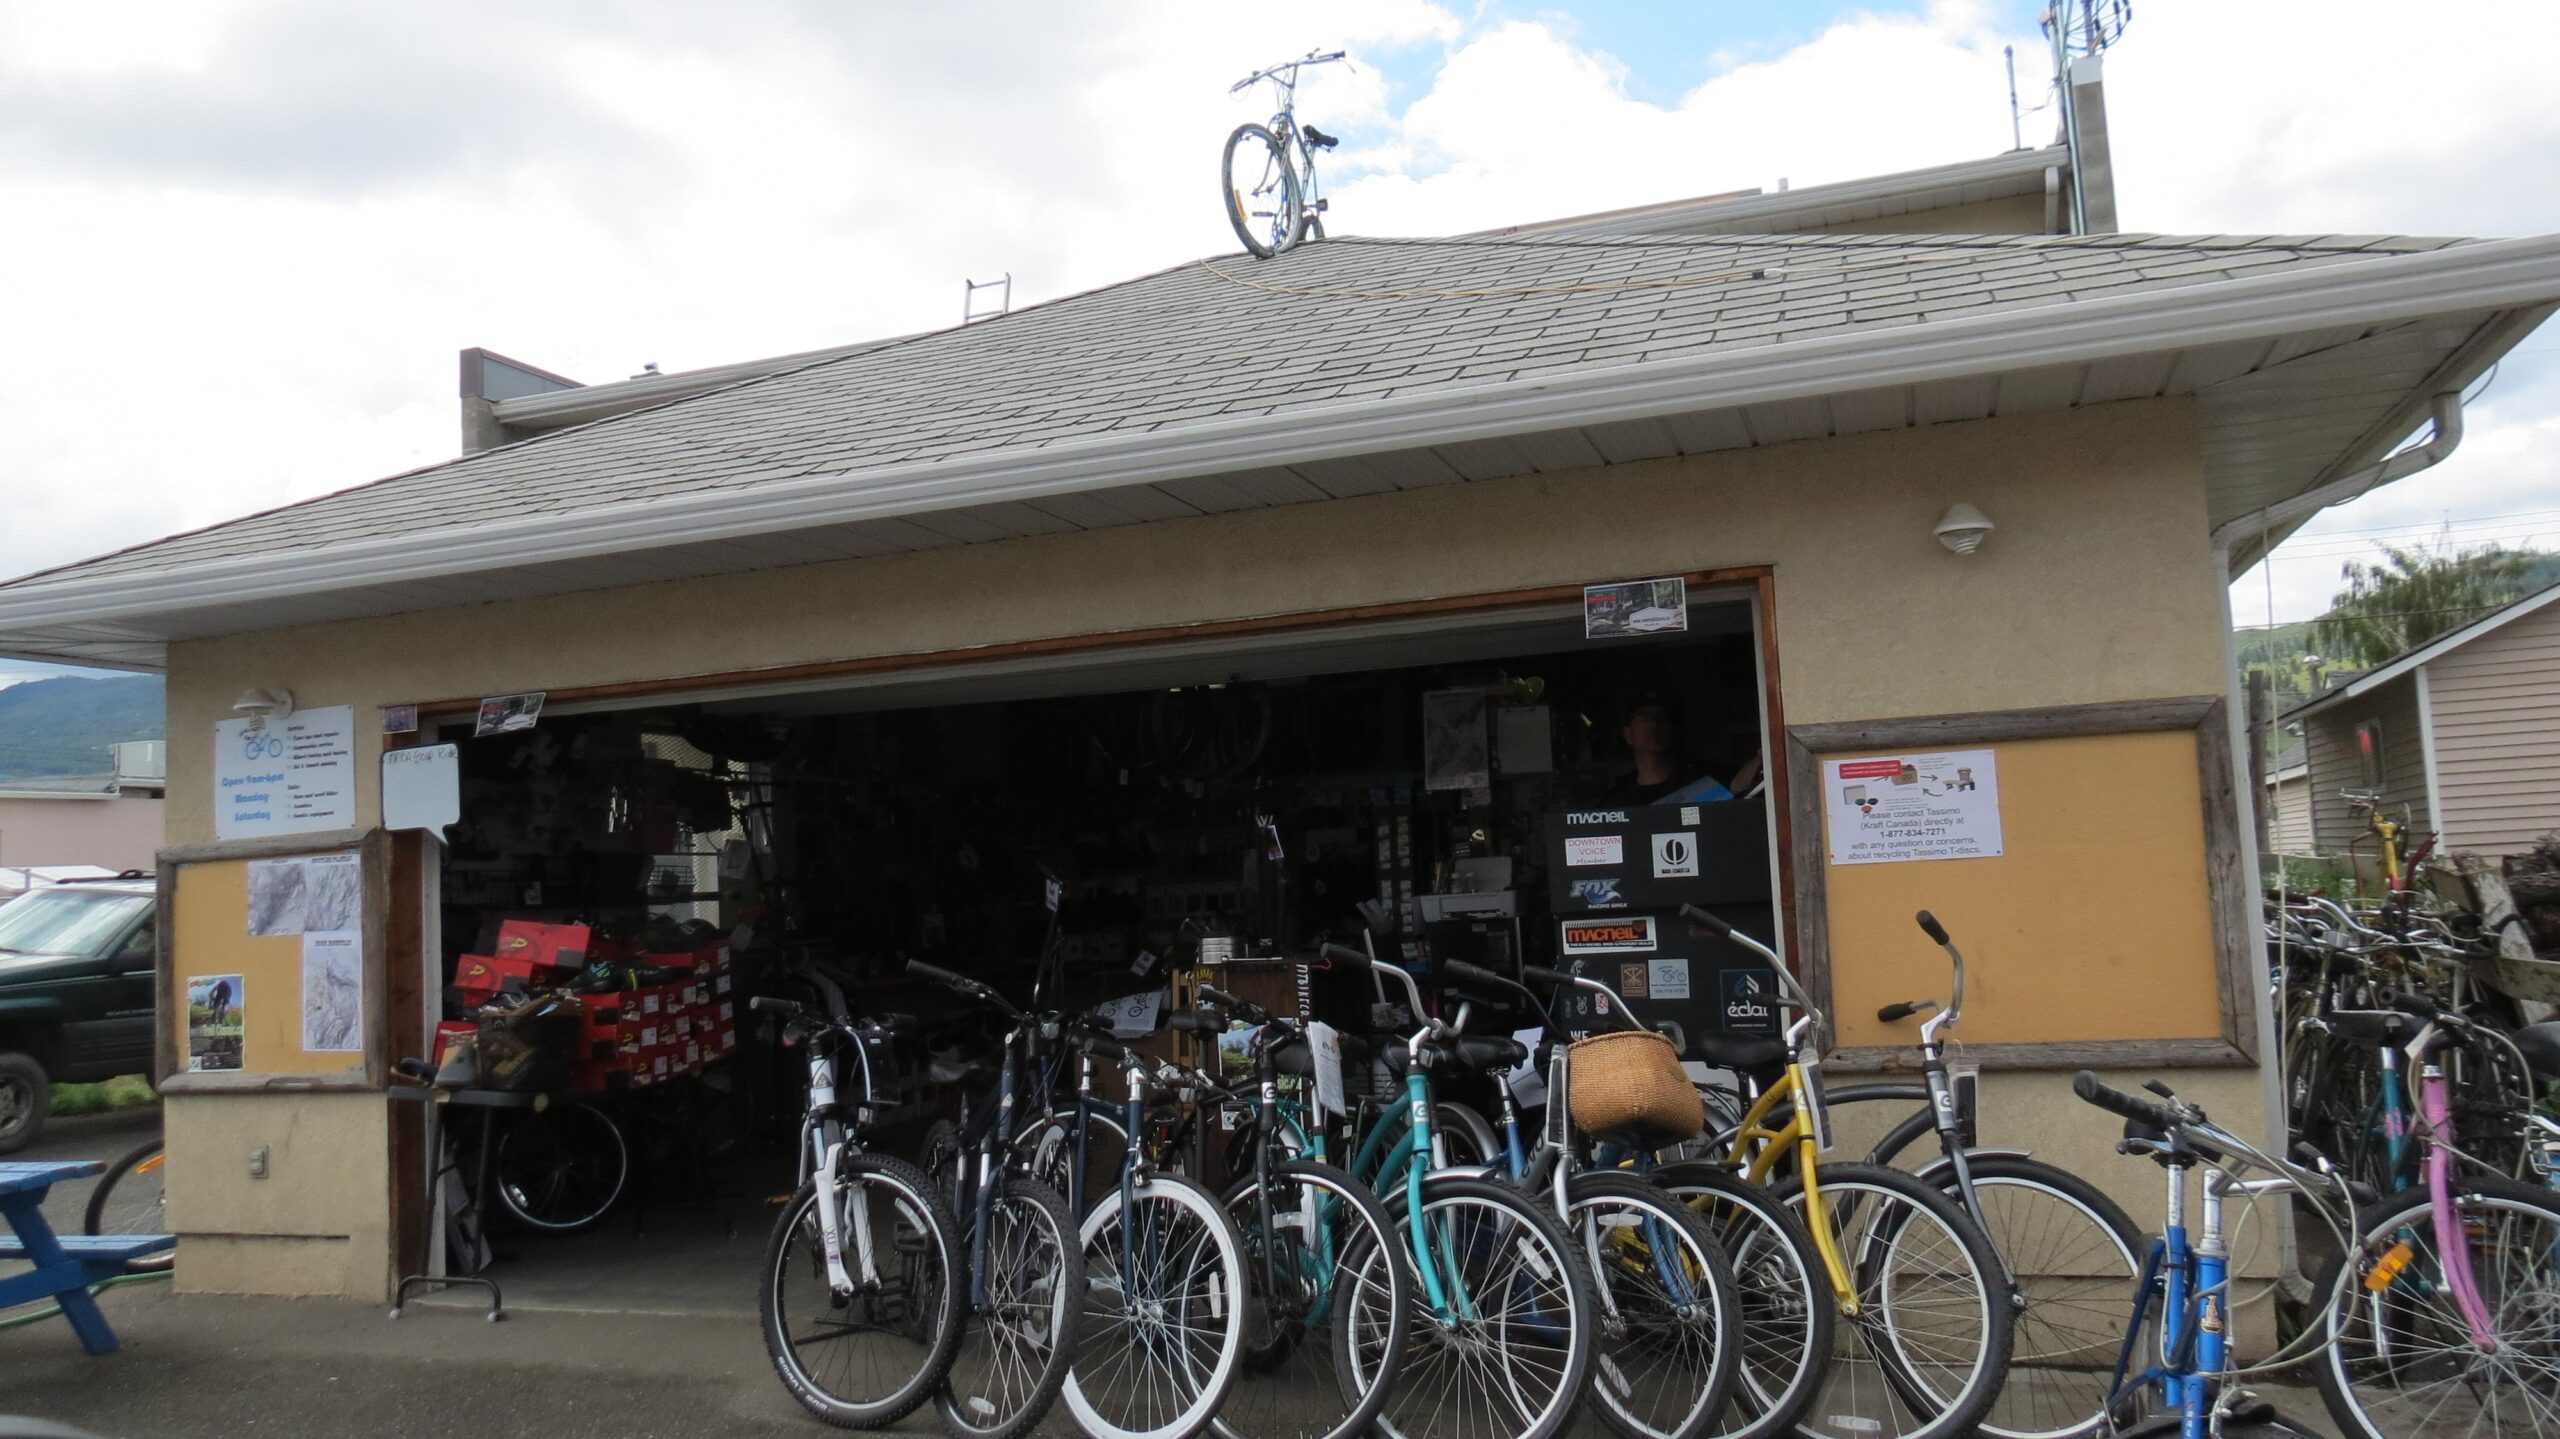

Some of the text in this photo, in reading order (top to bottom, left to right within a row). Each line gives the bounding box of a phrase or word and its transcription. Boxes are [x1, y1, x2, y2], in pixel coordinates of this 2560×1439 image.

[1863, 808, 1961, 820] Please contact Tassimo
[1861, 821, 1884, 830] (Kraft
[1885, 818, 1922, 829] Canada)
[1924, 818, 1954, 826] directly
[1880, 828, 1946, 838] 1-877-834-7271
[1568, 837, 1621, 848] DOWNTOWN
[1851, 842, 1868, 850] with
[1870, 842, 1886, 850] any
[1888, 839, 1924, 849] question
[1580, 847, 1606, 856] VOICE
[1848, 851, 1872, 860] about
[1874, 850, 1911, 860] recycling
[1913, 848, 1947, 856] Tassimo
[1569, 879, 1620, 898] FOX
